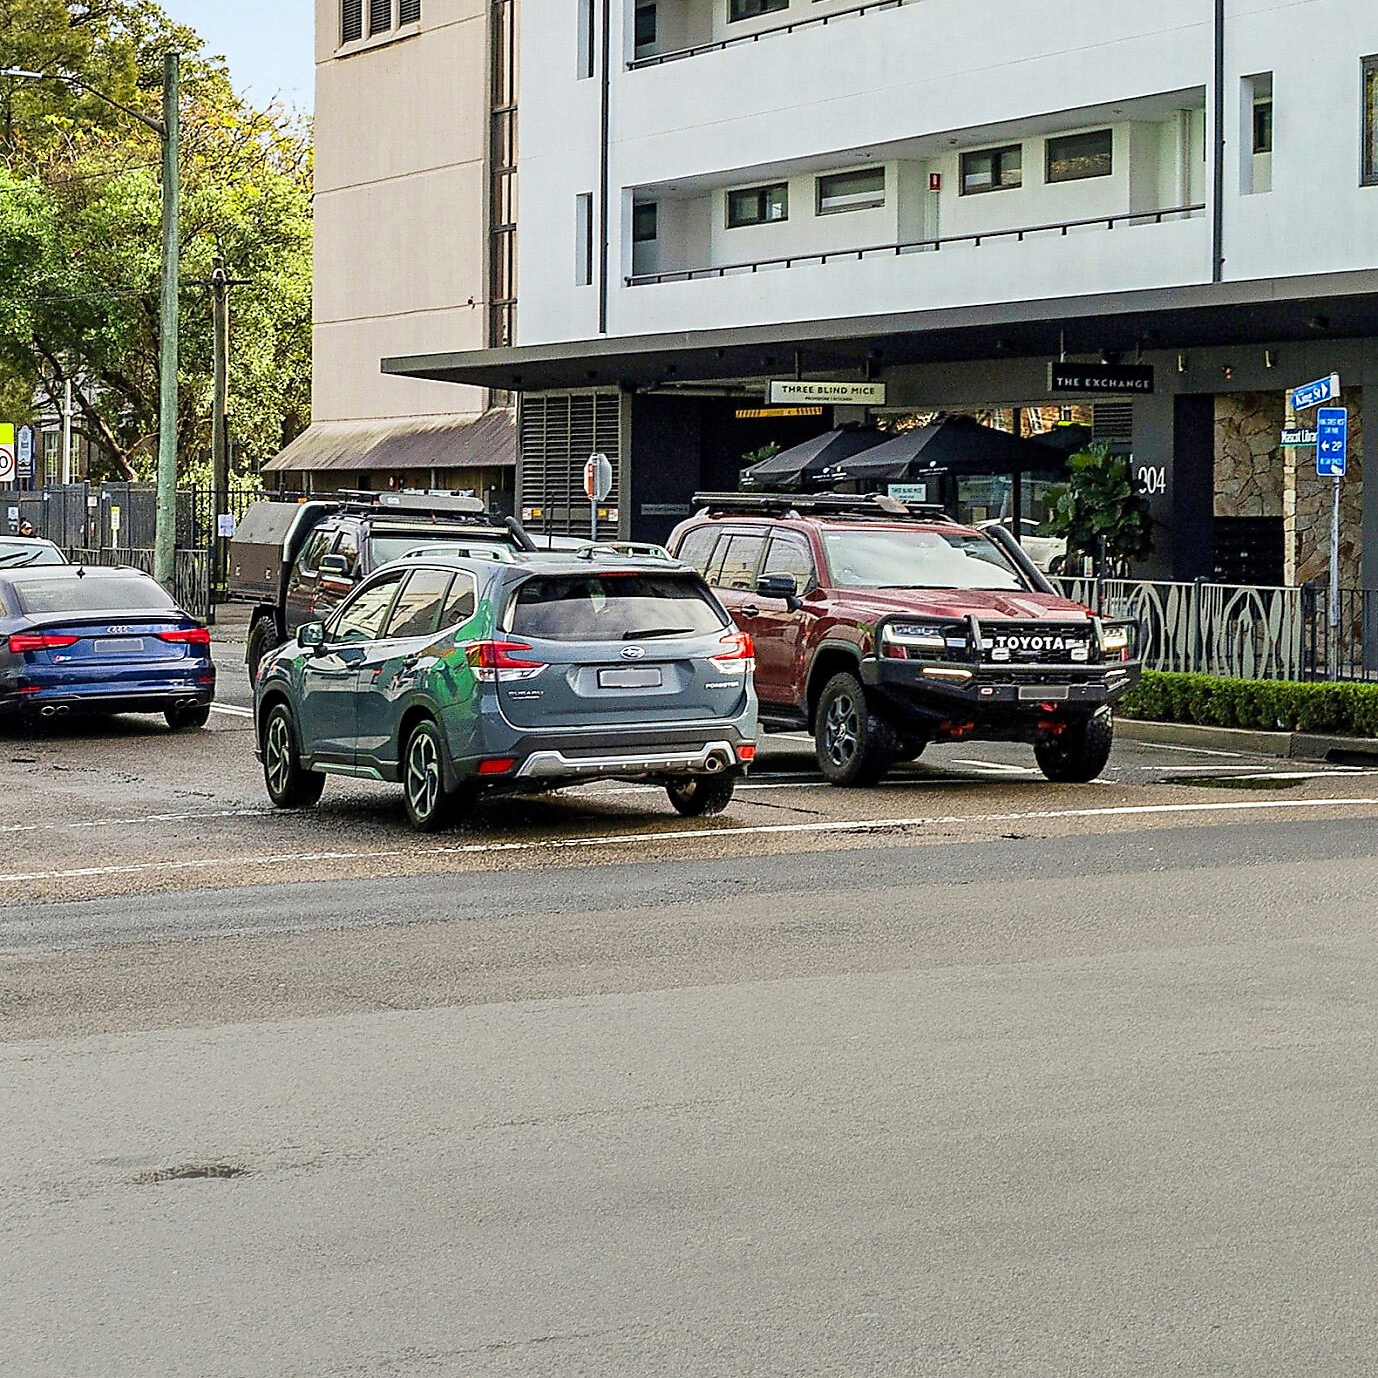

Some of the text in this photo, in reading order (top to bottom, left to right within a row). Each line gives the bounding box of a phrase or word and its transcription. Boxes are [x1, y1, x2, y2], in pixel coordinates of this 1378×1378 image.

[1056, 377, 1150, 389] THE EXCHANGE
[782, 385, 875, 395] THREE BLIND MICE
[1295, 387, 1321, 406] King St
[1281, 429, 1318, 443] Mascot Librar
[1331, 441, 1343, 452] 2P
[996, 636, 1065, 650] TOYOTA
